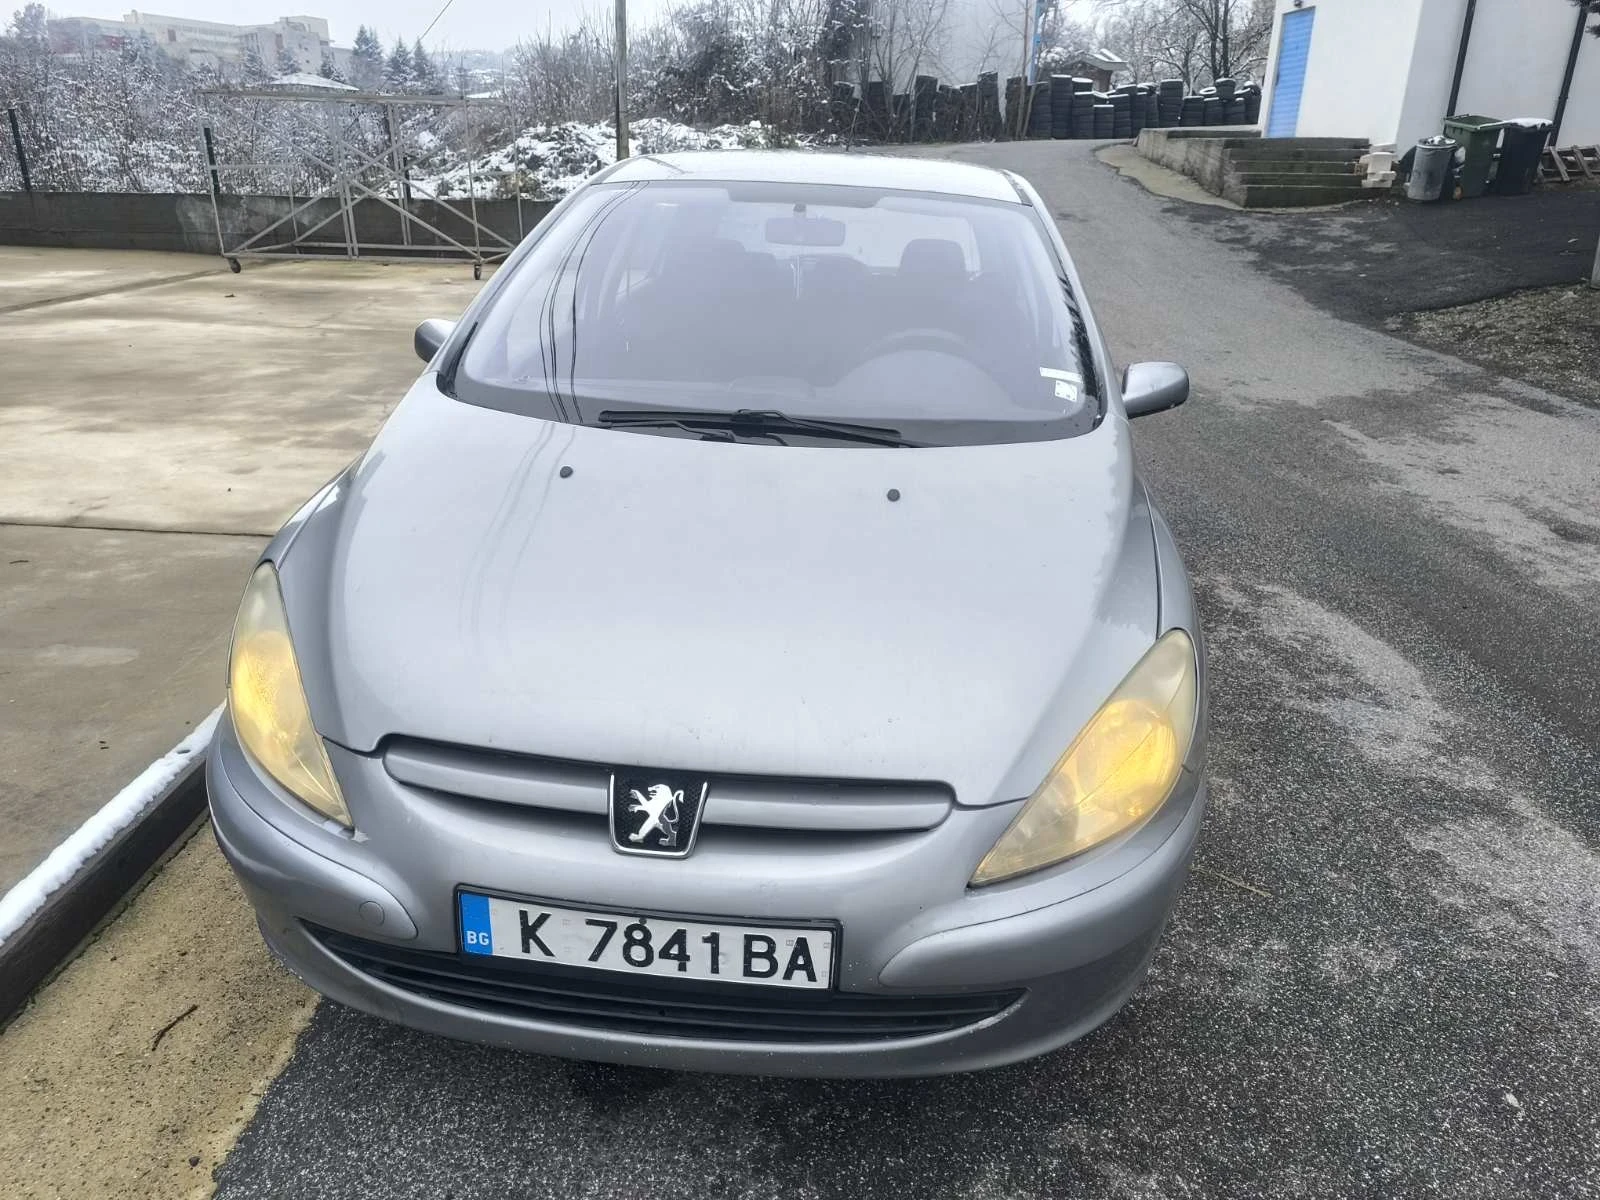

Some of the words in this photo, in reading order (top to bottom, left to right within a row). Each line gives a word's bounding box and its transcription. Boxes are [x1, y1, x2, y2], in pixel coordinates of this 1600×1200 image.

[466, 931, 490, 946] BG
[519, 909, 555, 957] K
[585, 918, 721, 975] 7841
[743, 934, 818, 982] BA
